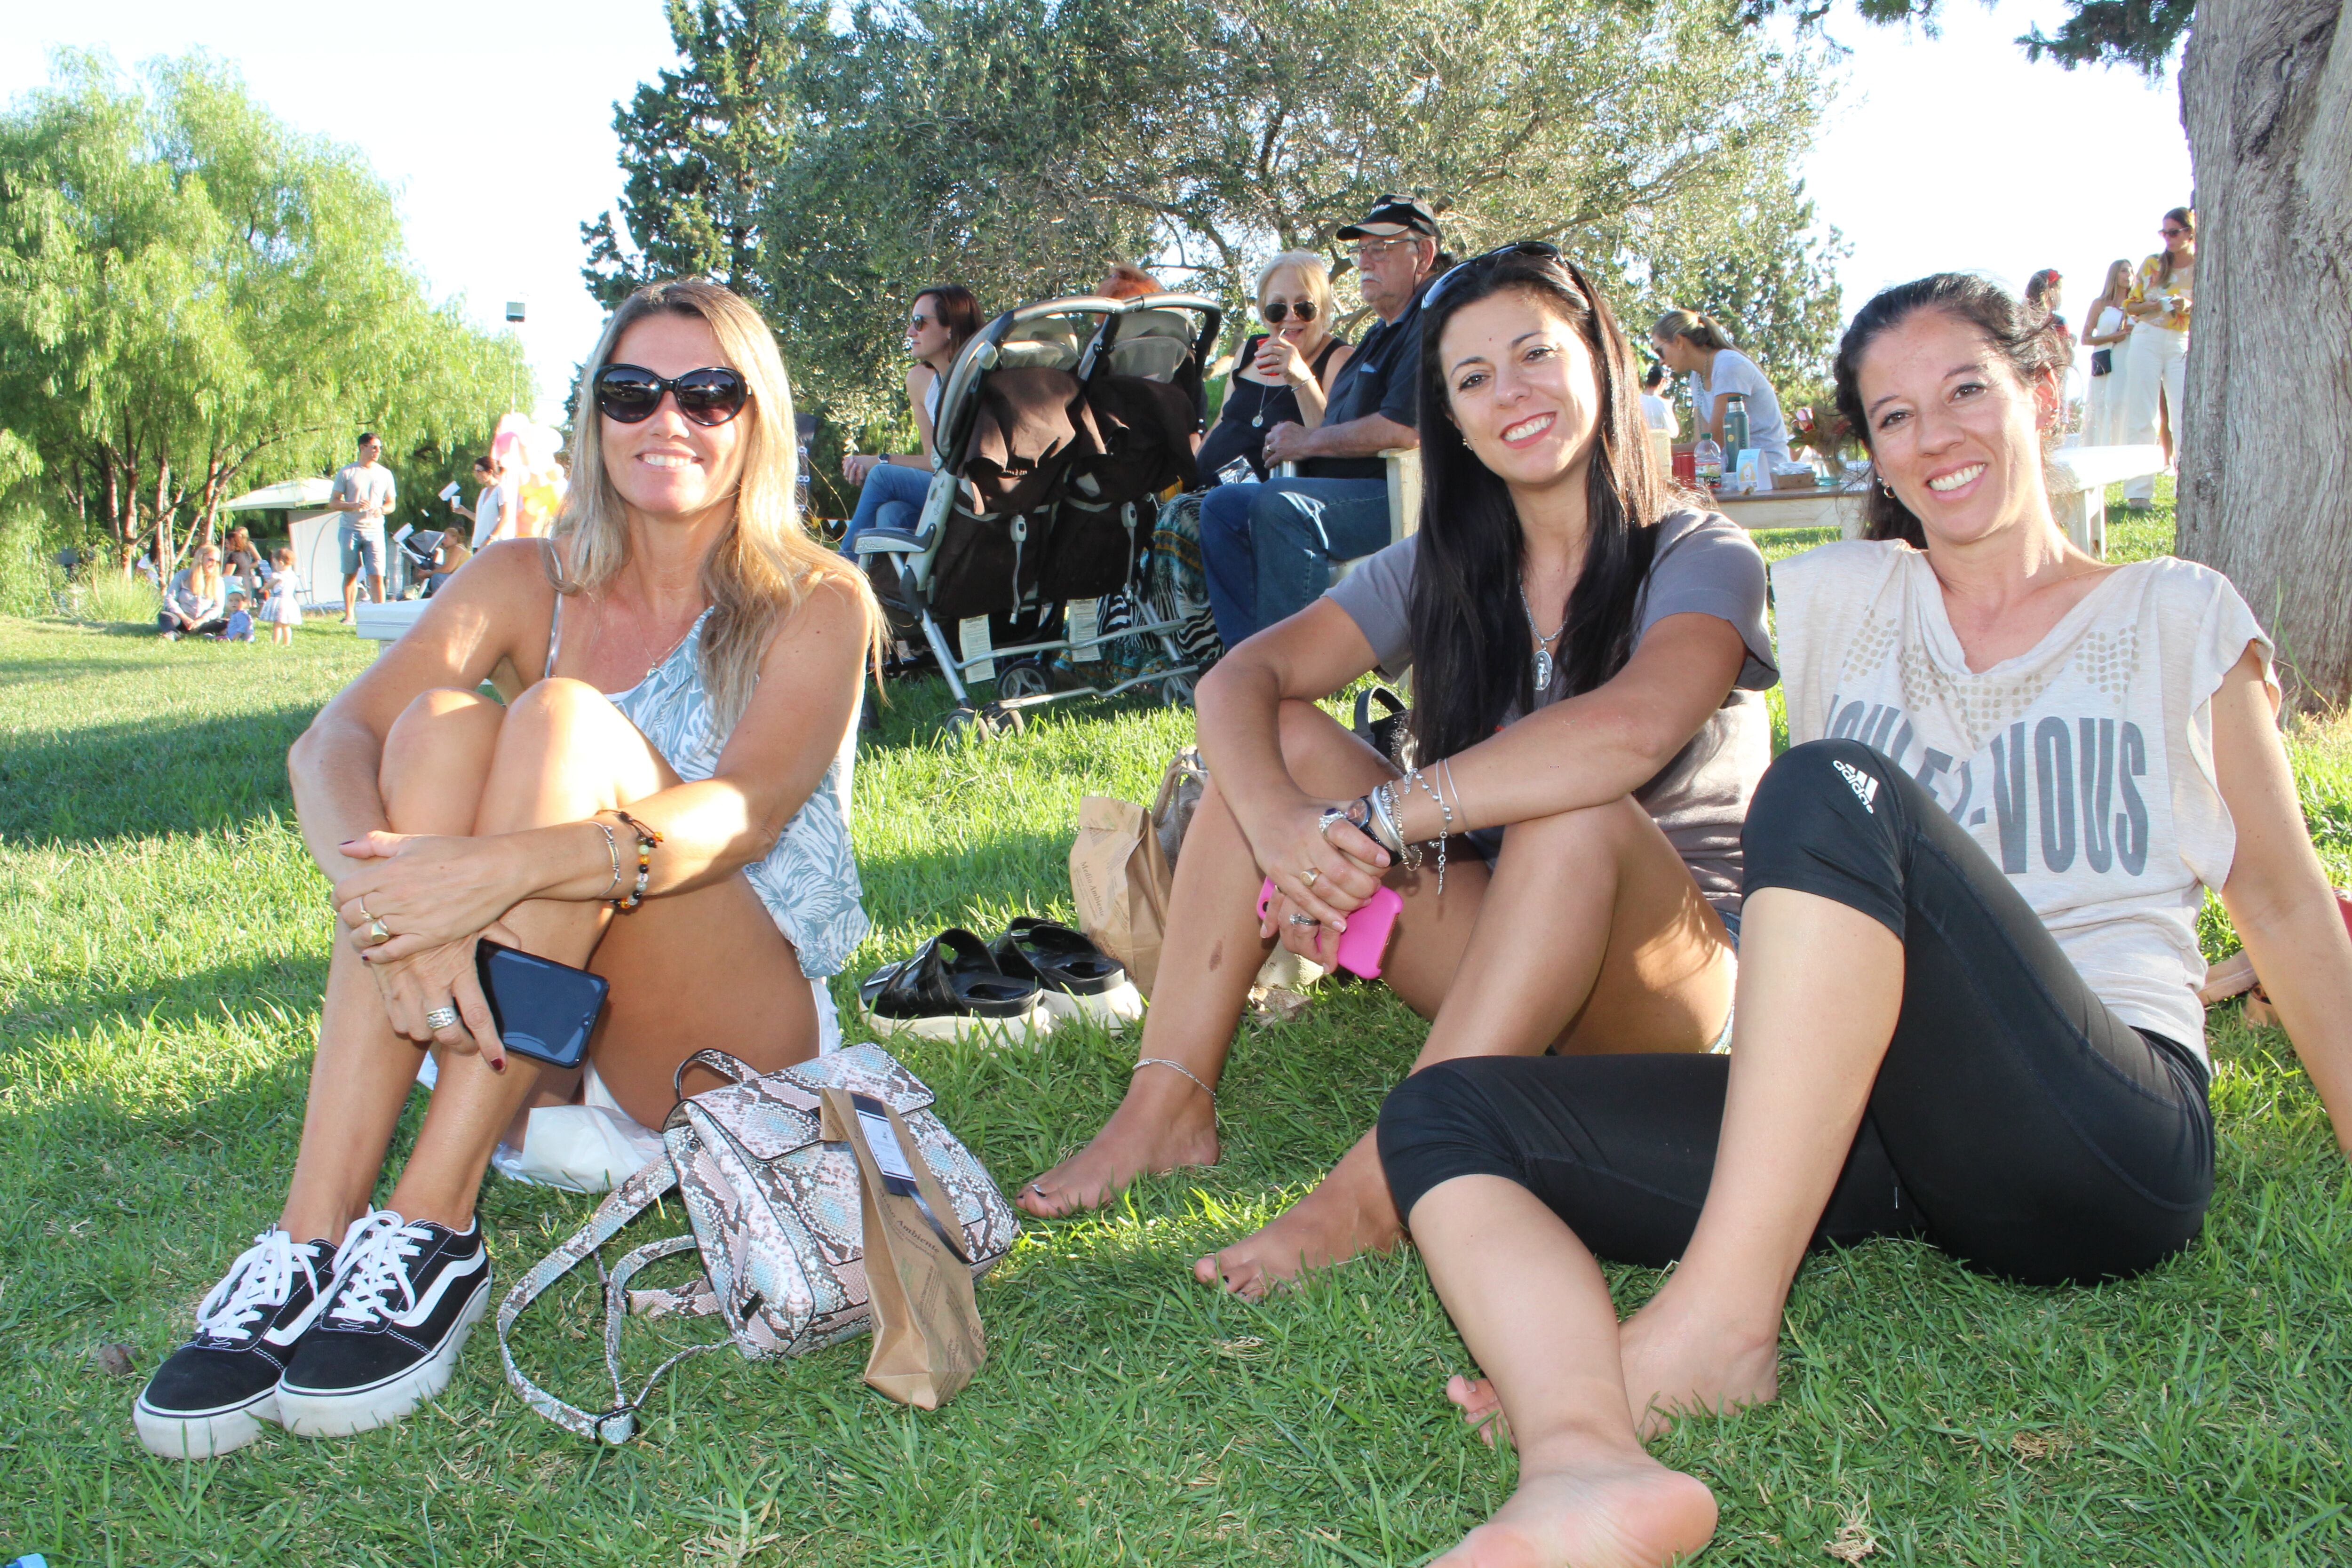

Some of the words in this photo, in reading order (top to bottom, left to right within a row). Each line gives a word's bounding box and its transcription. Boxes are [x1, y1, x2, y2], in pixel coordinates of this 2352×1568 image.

[1823, 693, 2148, 876] E-VOUS
[1833, 760, 1874, 814] adidas
[1081, 861, 1093, 883] Medio
[1089, 885, 1104, 917] Ambiente
[897, 1220, 940, 1253] Ambiente
